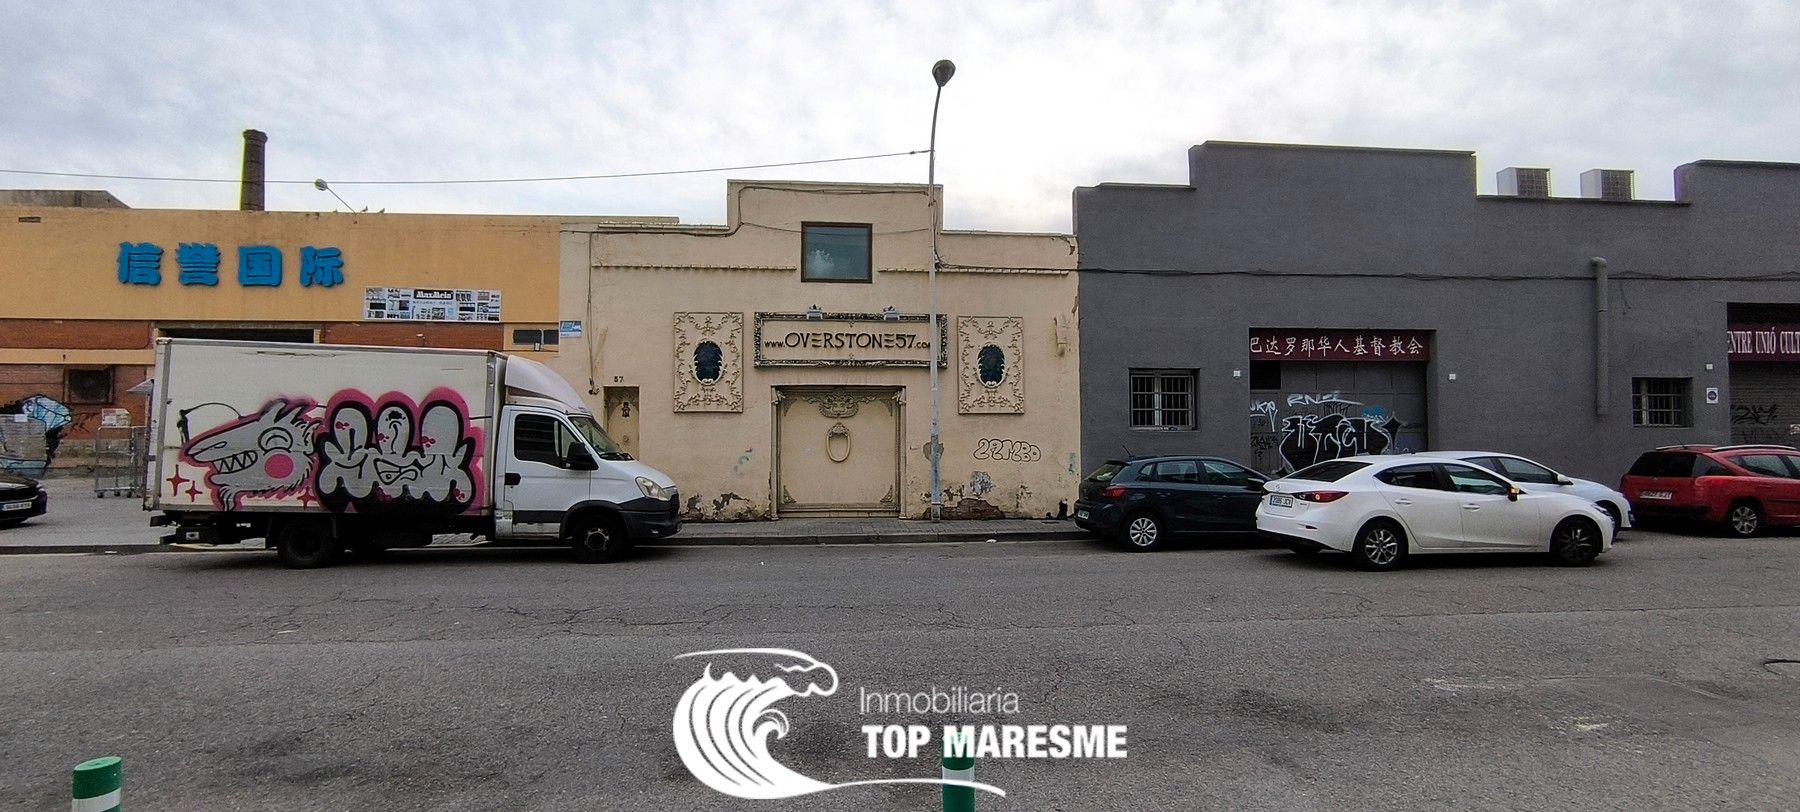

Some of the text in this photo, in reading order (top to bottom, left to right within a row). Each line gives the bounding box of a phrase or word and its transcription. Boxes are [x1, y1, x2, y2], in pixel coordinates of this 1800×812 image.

[117, 242, 344, 287] 信誉国际
[764, 332, 931, 350] www.OVERSTONE57.co
[1250, 336, 1423, 358] 巴达罗那华人基督教会
[1755, 326, 1777, 354] UNIÓ
